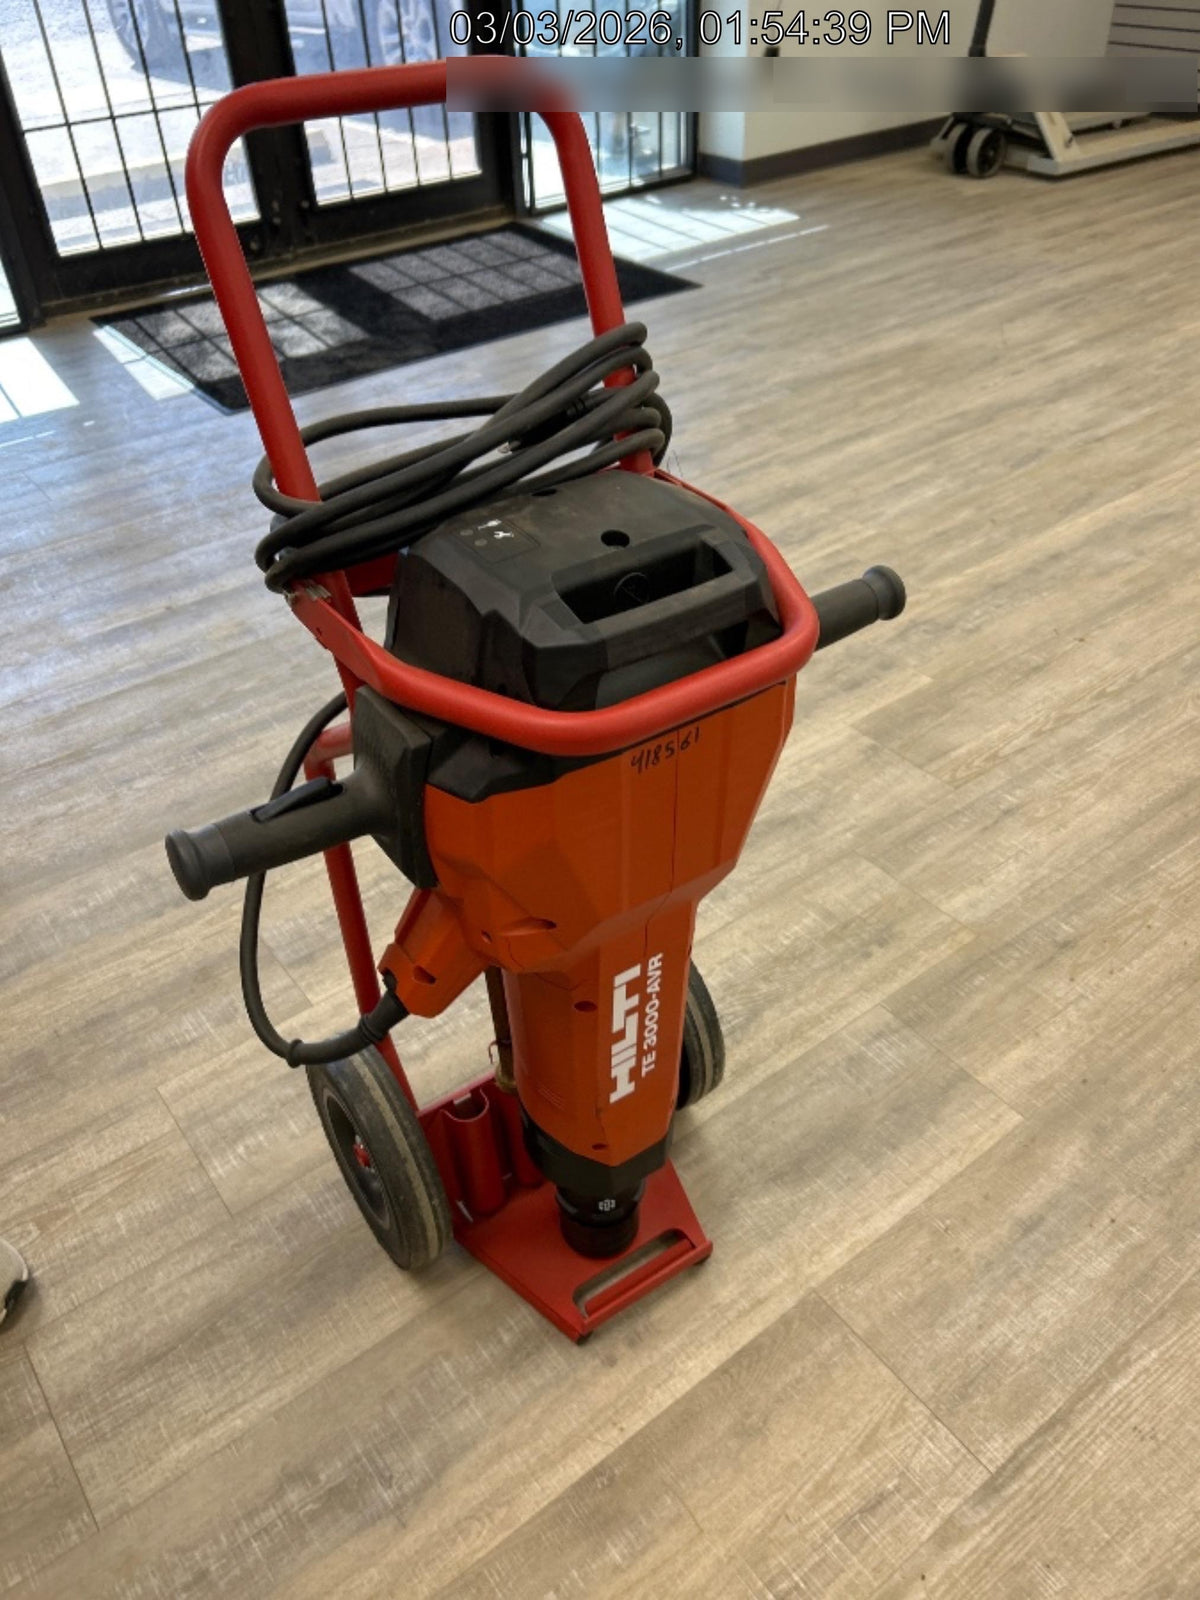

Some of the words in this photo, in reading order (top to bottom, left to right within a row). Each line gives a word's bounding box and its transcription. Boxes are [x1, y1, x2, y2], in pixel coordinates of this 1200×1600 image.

[630, 726, 699, 775] 418561
[609, 963, 642, 1105] HILTI
[643, 952, 664, 1051] 3000-AVR
[641, 1050, 657, 1078] TE
